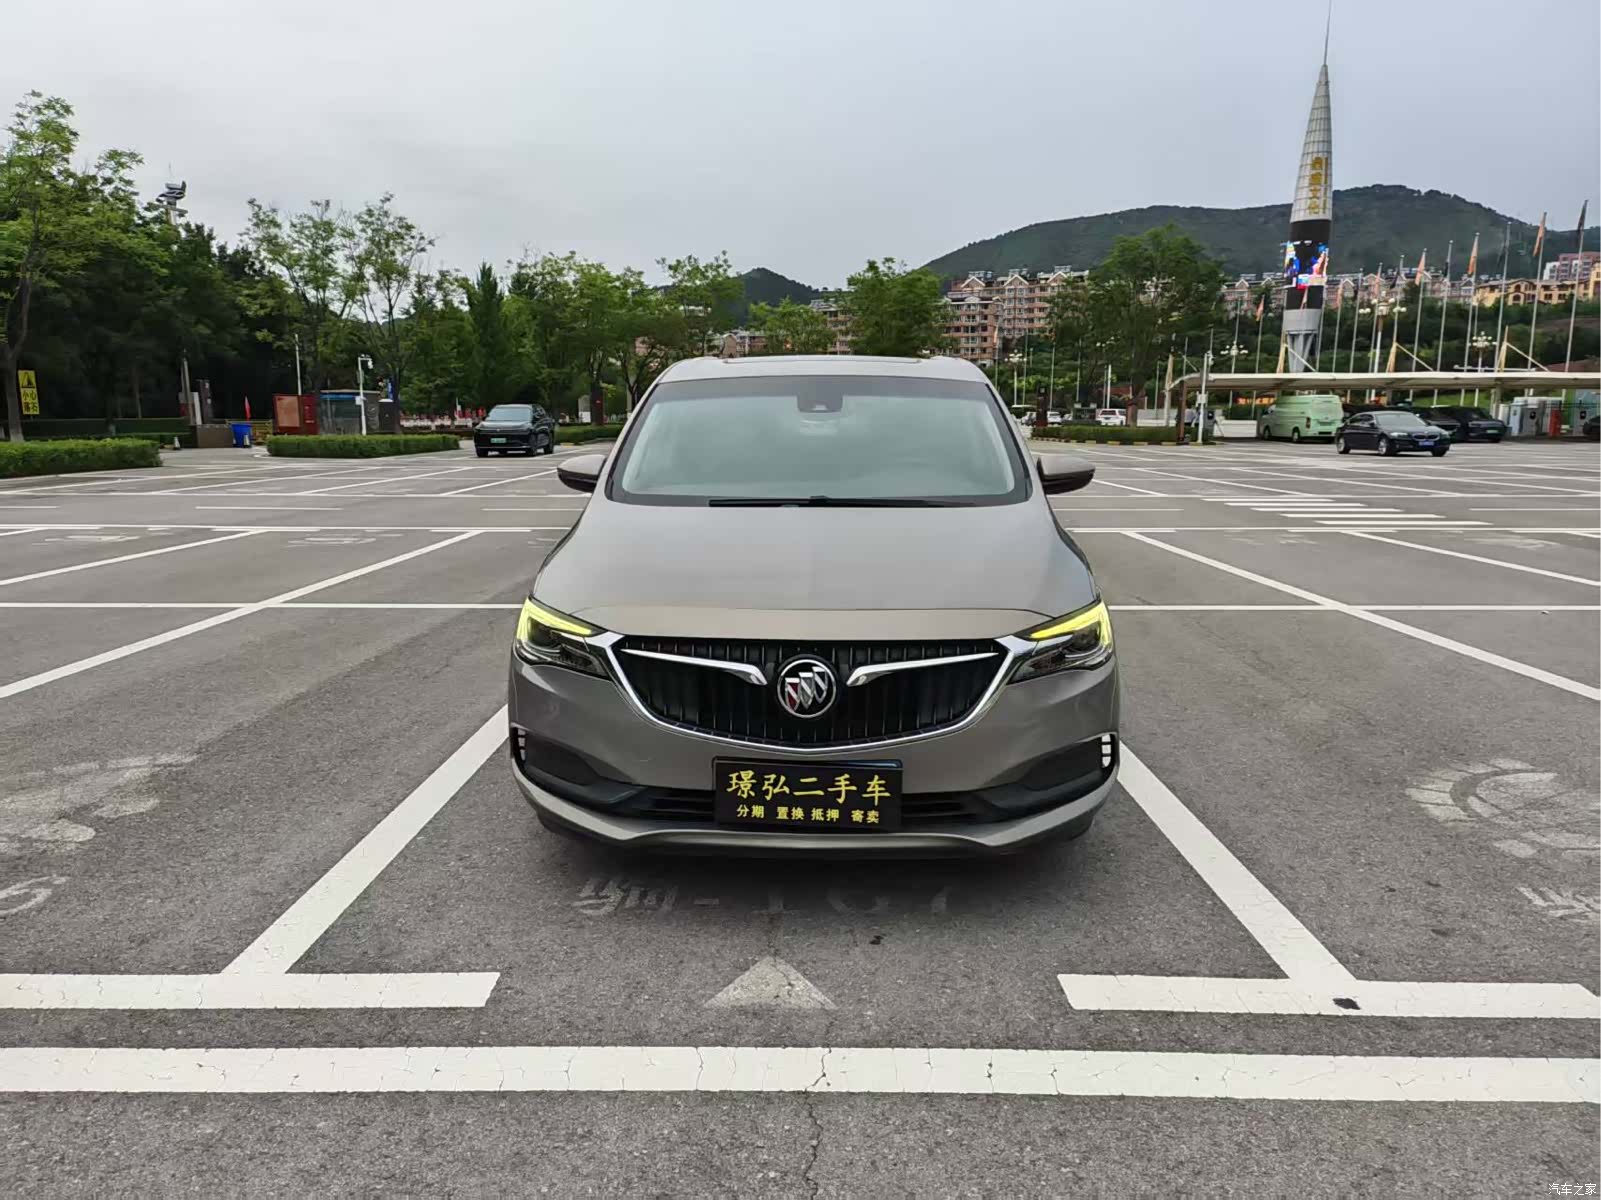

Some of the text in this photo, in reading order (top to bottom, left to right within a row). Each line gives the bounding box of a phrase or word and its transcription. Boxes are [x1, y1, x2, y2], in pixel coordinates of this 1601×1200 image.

[22, 389, 37, 401] 小心
[726, 769, 892, 807] 璟弘二手车
[736, 803, 880, 824] 分期 置换 抵押 寄卖
